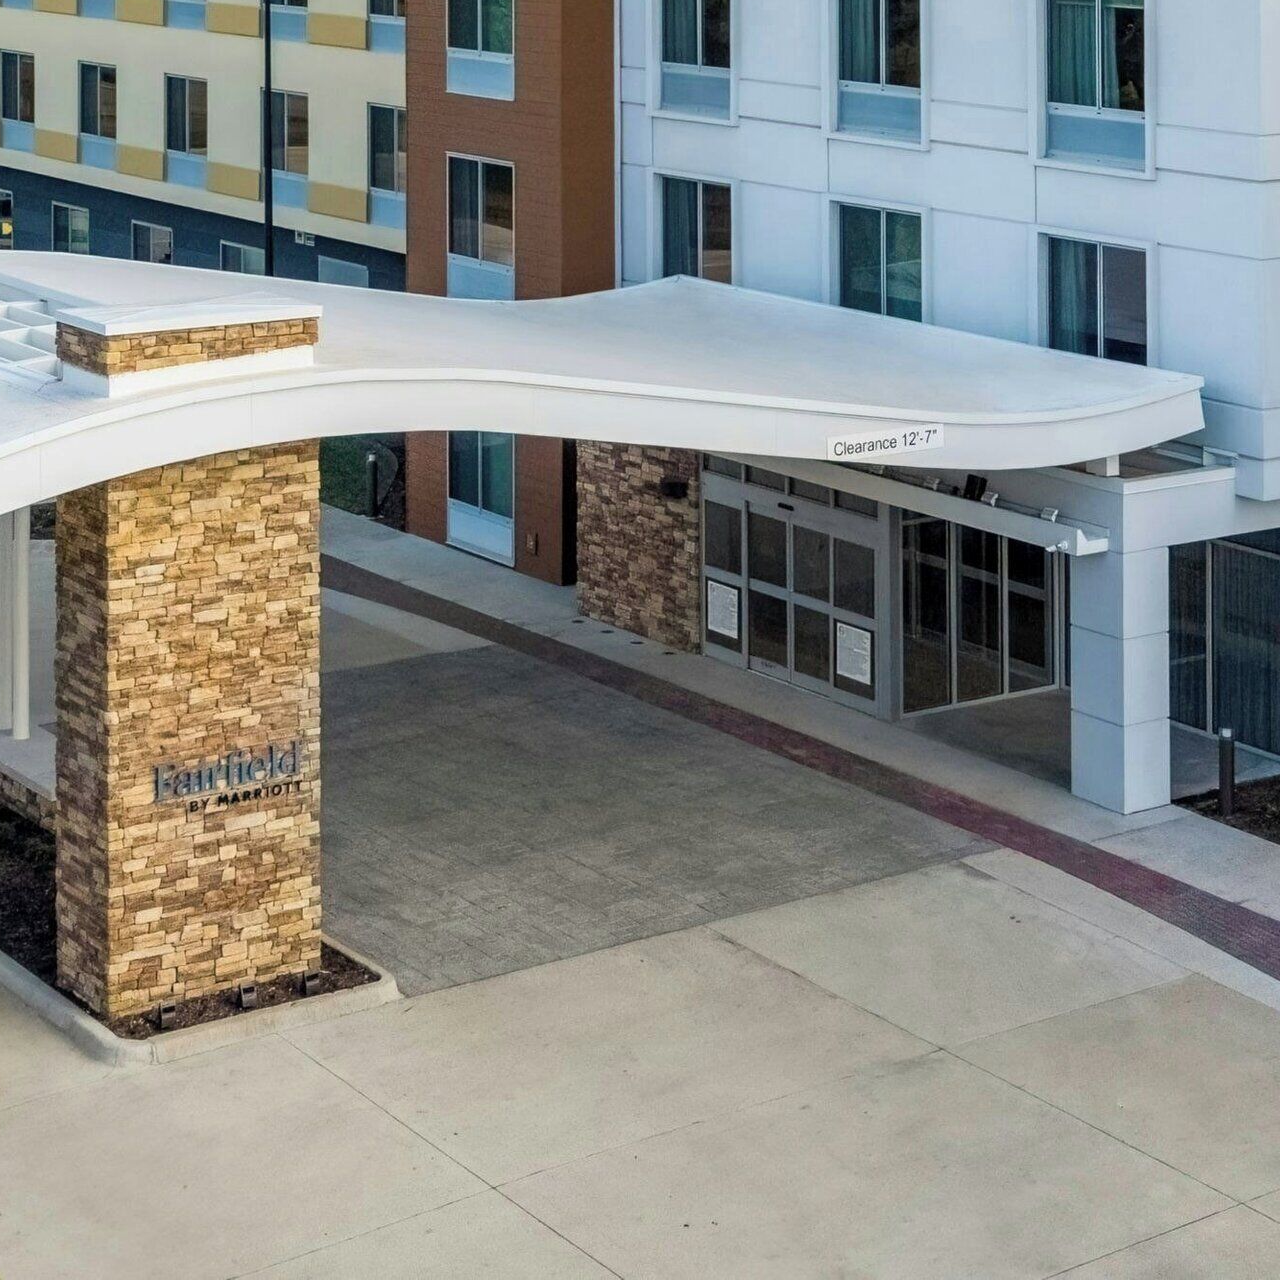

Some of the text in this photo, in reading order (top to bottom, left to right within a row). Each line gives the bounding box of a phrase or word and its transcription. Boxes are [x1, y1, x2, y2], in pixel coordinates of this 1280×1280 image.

[833, 437, 897, 456] Clearance
[153, 740, 302, 803] Fairfield
[189, 780, 302, 813] BY MARRIOTT
